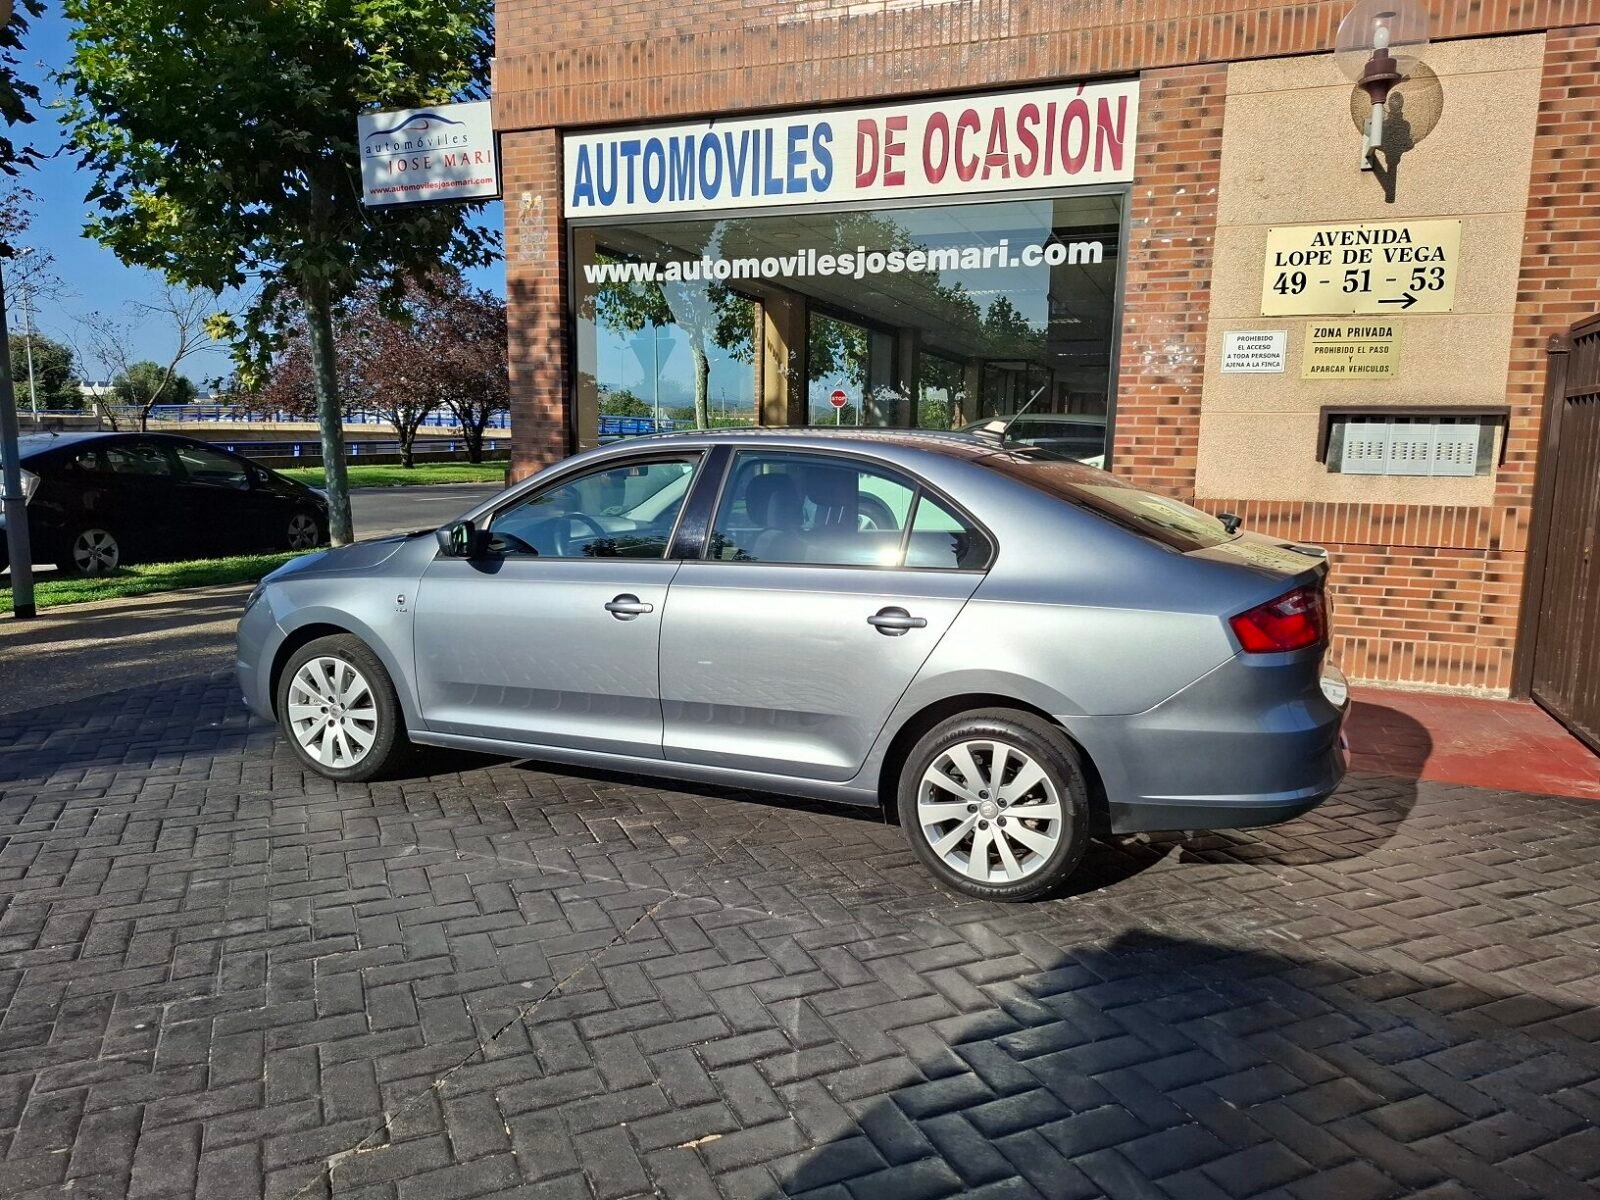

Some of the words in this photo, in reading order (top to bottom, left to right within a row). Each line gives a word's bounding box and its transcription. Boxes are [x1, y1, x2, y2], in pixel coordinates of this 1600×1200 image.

[365, 134, 468, 154] automóviles
[572, 119, 833, 207] AUTOMÓVILES
[856, 115, 908, 188] DE
[922, 83, 1128, 184] OCASIÓN
[388, 156, 431, 175] JOSE
[444, 150, 491, 167] MARI
[370, 177, 493, 195] www.automovilesjosemari.com
[1311, 228, 1412, 247] AVENIDA
[583, 239, 1103, 284] www.automovilesjosemari.com
[1275, 250, 1332, 267] LOPE
[1342, 249, 1373, 265] DE
[1383, 246, 1446, 263] VEGA
[1273, 271, 1307, 295] 49
[1342, 269, 1372, 293] 51
[1409, 266, 1446, 291] 53
[1313, 327, 1342, 338] ZONA
[1347, 327, 1393, 338] PRIVADA
[1314, 346, 1354, 354] PROHIBIDO
[1357, 346, 1366, 354] EL
[1369, 346, 1389, 354] PASO
[1348, 355, 1353, 363] Y
[1311, 365, 1345, 373] APARCAR
[1348, 365, 1390, 373] VEHICULOS
